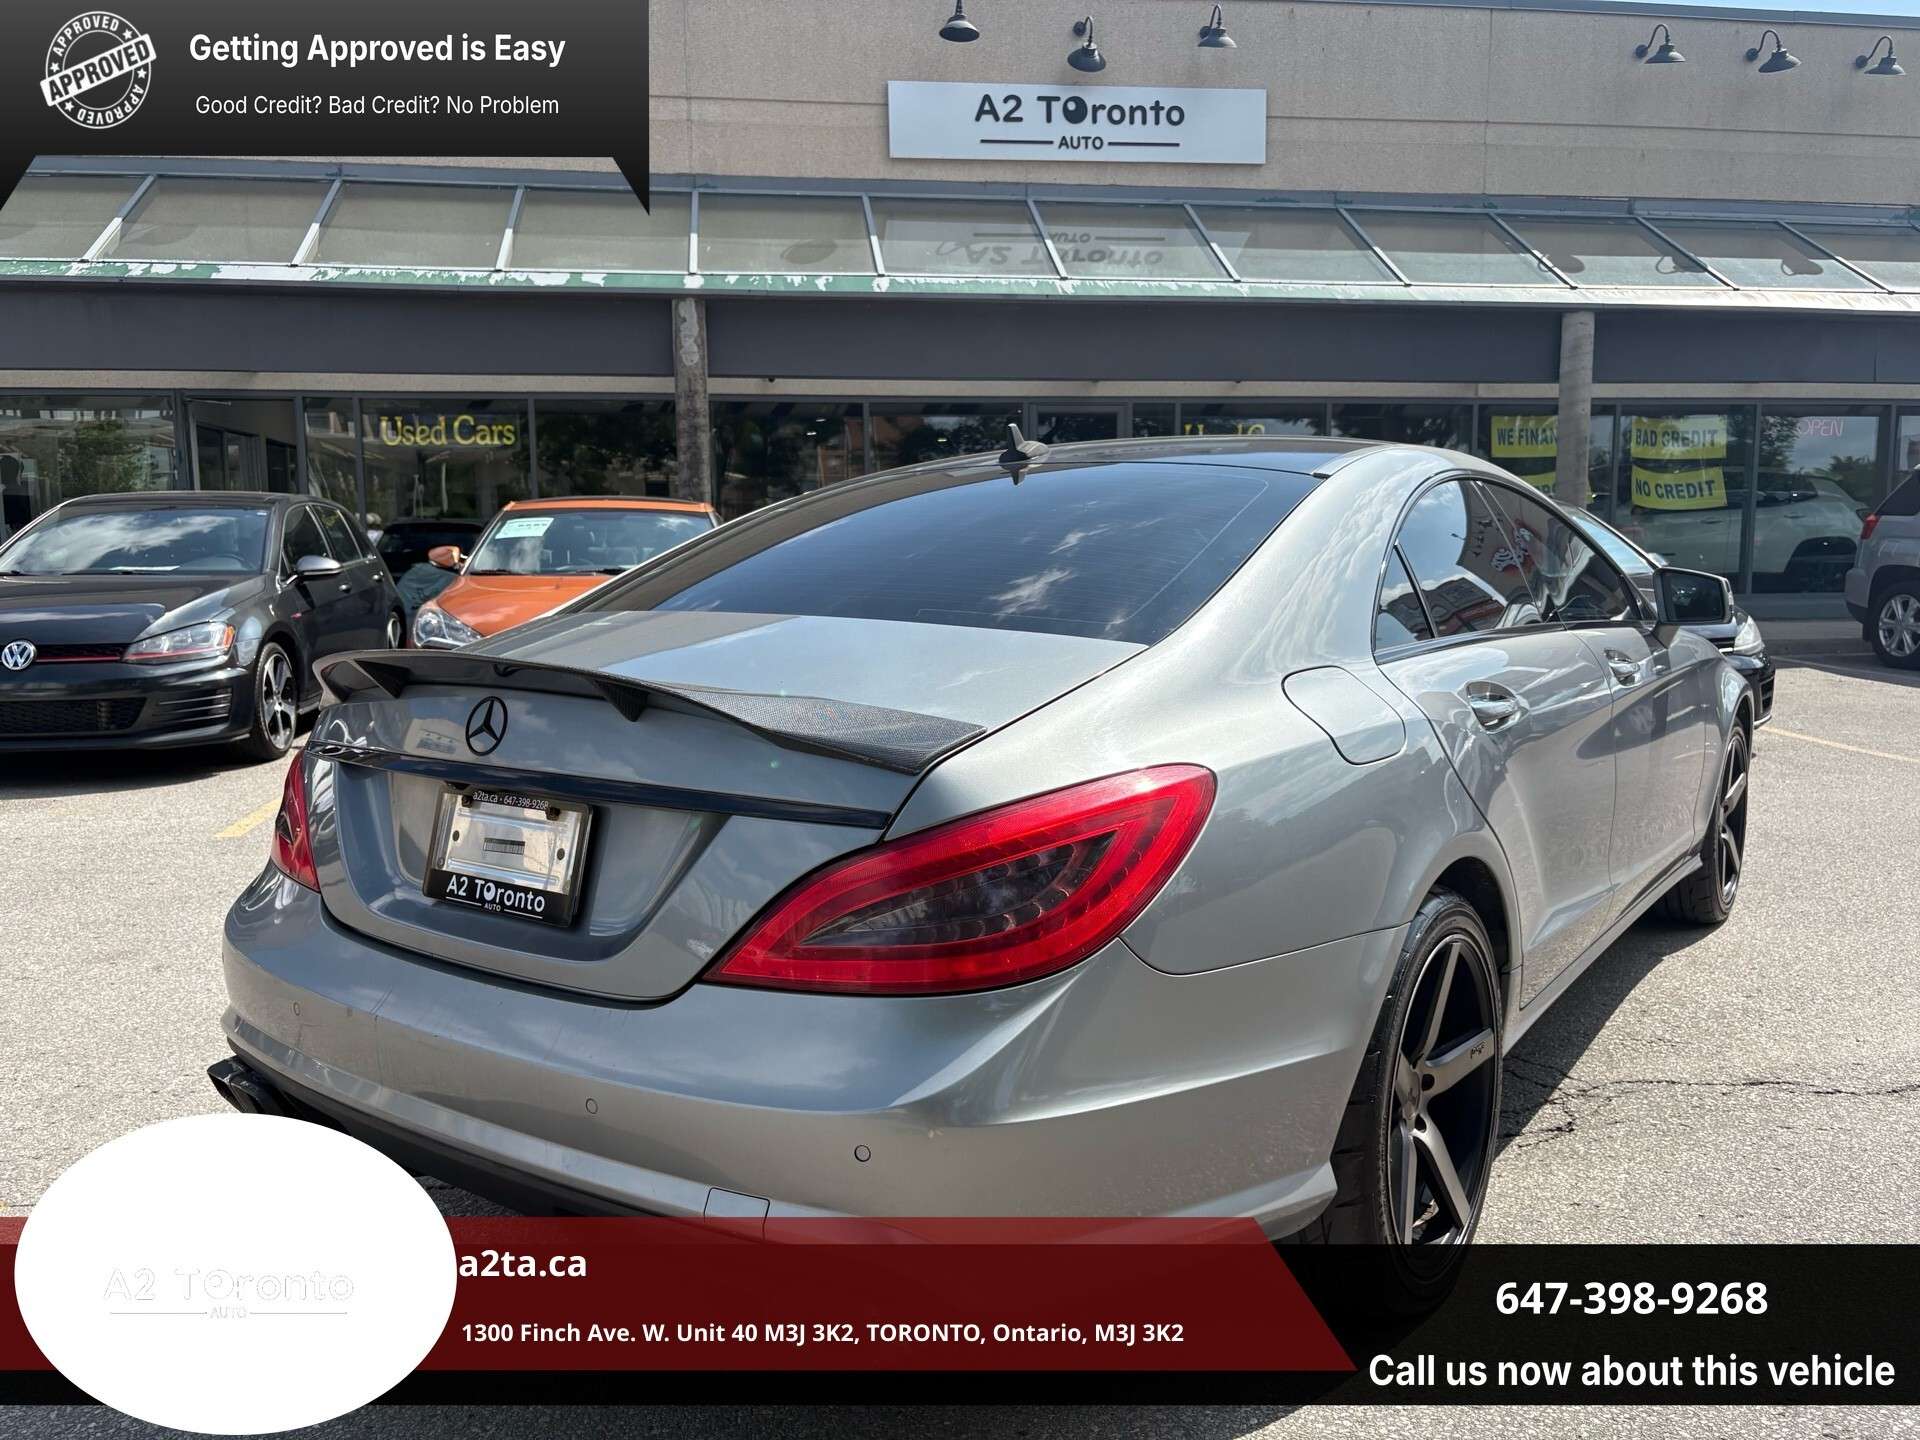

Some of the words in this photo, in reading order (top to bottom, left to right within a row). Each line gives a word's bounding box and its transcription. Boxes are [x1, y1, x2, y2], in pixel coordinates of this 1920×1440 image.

[975, 94, 1024, 123] A2
[1058, 136, 1104, 151] AUTO
[380, 415, 447, 447] Used
[453, 414, 516, 446] Cars
[1497, 428, 1514, 446] WE
[1796, 417, 1844, 437] OPEN
[1635, 428, 1658, 447] BAD
[1661, 429, 1718, 448] CREDIT
[1635, 478, 1651, 497] NO
[1655, 479, 1715, 499] CREDIT
[446, 874, 469, 897] A2
[483, 903, 502, 912] AUTO
